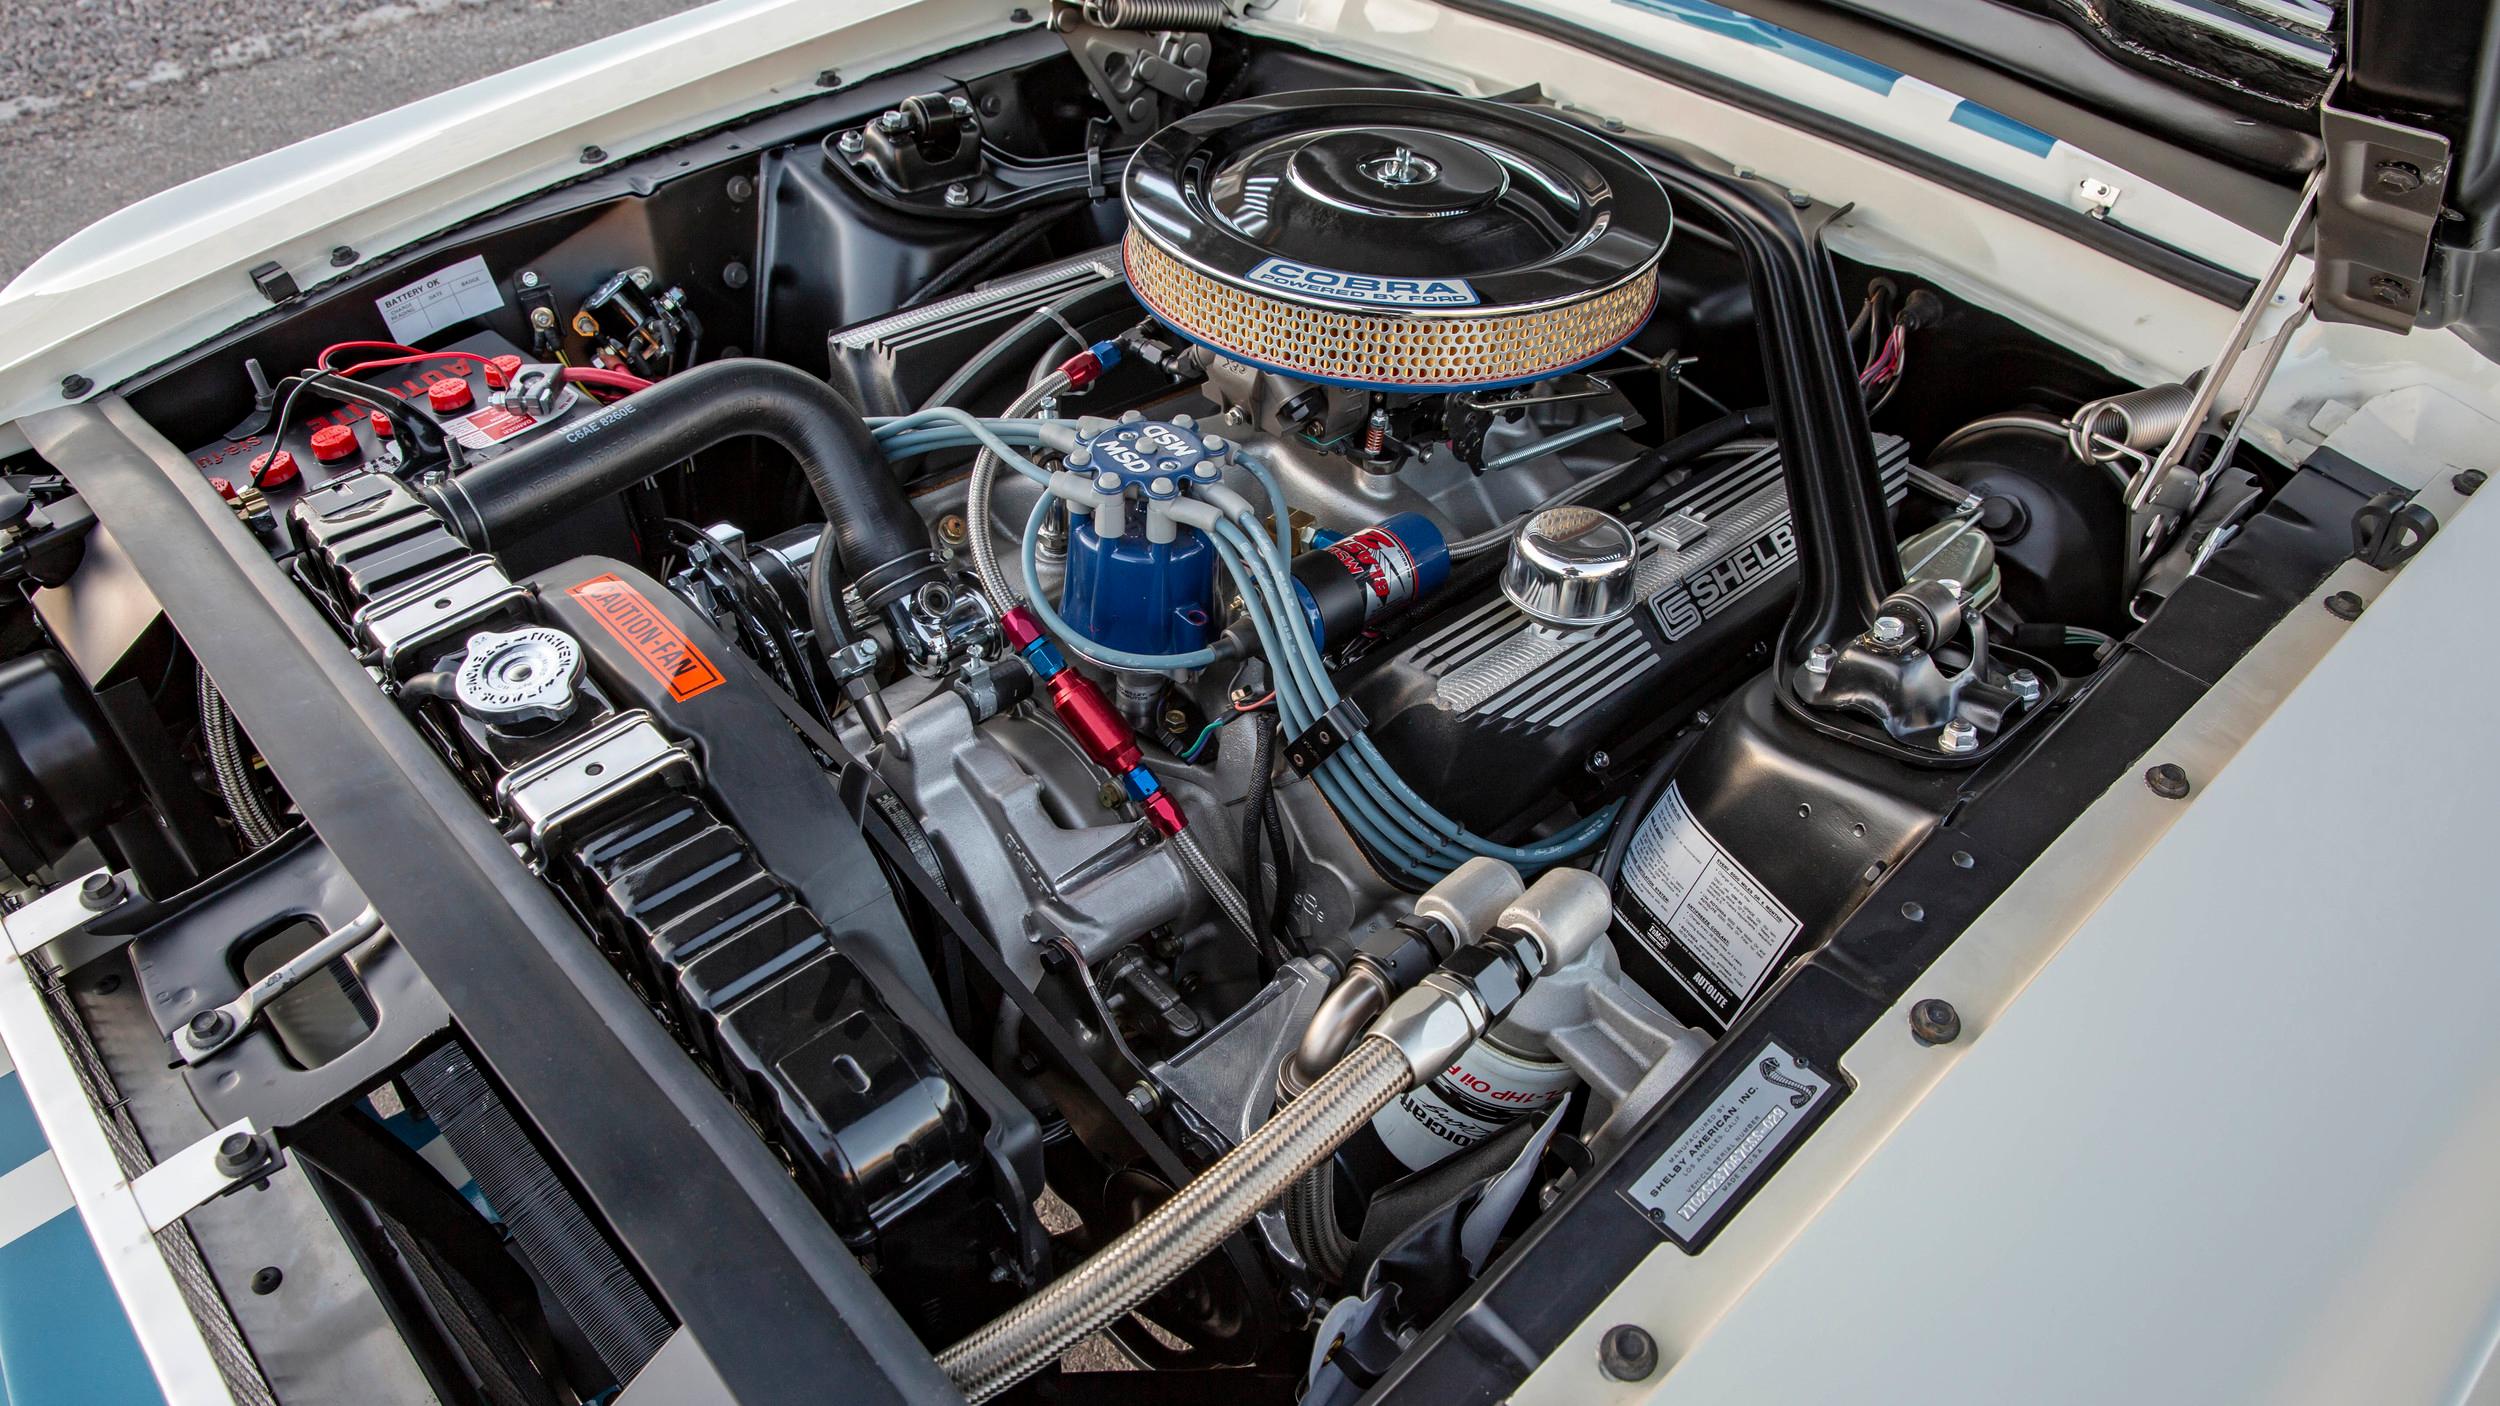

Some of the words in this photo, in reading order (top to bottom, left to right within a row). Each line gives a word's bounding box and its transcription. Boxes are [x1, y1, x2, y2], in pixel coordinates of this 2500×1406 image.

[385, 286, 424, 308] BATTERY
[426, 279, 440, 289] OK
[1260, 273, 1366, 299] POWERED
[1373, 293, 1402, 302] BY
[1408, 294, 1468, 303] FORD
[1269, 264, 1459, 295] COBRA
[566, 421, 601, 445] C6AE
[600, 404, 637, 429] 8260E
[1143, 425, 1198, 457] MSD
[1096, 440, 1151, 473] MSD
[1690, 521, 1798, 608] SHELB
[590, 585, 697, 678] CAUTION-FAN
[1692, 972, 1729, 1009] AUTOLITE
[1459, 1073, 1491, 1093] Oil
[1400, 1093, 1476, 1147] orcraft
[1667, 1113, 1717, 1164] MANUFACTURED
[1716, 1103, 1726, 1113] BY
[1648, 1156, 1689, 1198] SHELBY
[1737, 1083, 1759, 1104] INC.
[1685, 1165, 1713, 1194] VEHICLE
[1712, 1141, 1735, 1165] SERIAL
[1734, 1114, 1760, 1142] NUMBER
[1682, 1162, 1696, 1177] LOS
[1721, 1172, 1740, 1192] MADE
[1738, 1164, 1747, 1173] IN
